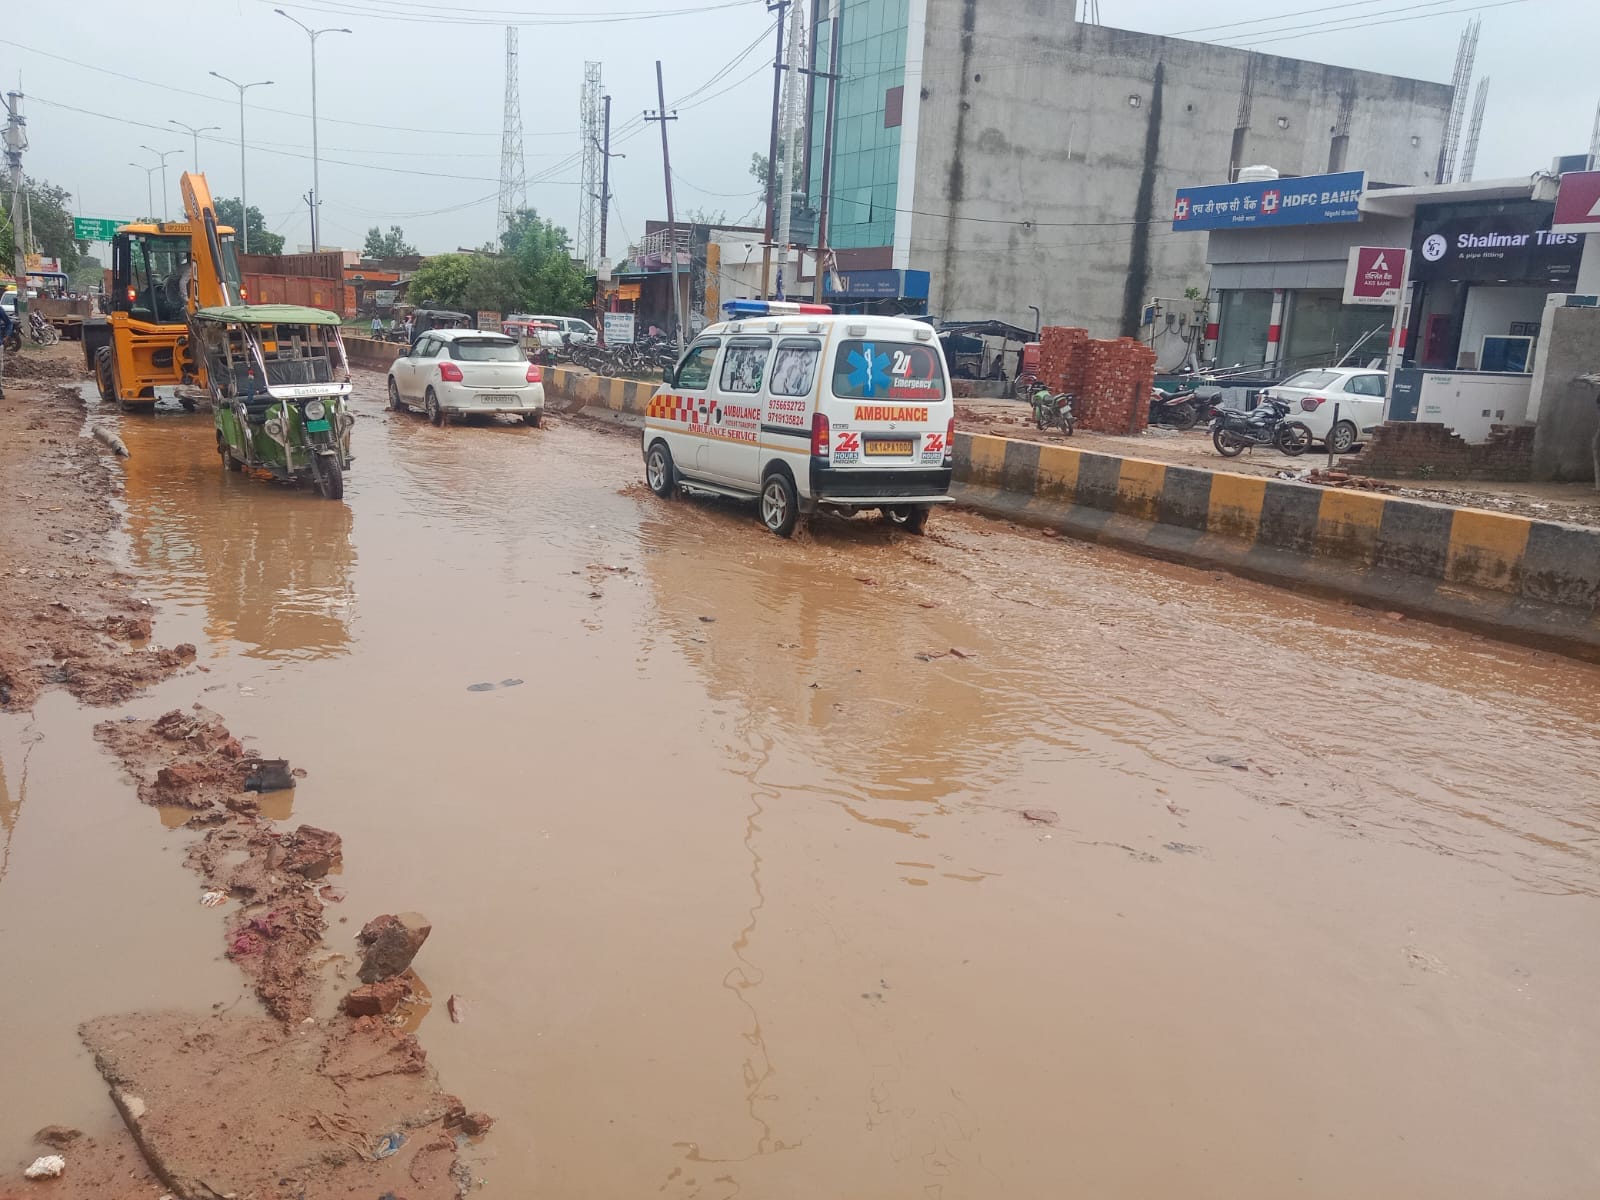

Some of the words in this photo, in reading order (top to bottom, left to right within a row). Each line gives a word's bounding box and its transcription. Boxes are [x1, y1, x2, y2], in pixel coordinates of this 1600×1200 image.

[1282, 193, 1318, 208] HDFC
[1321, 189, 1360, 204] BANK
[1457, 232, 1530, 248] Shalimar
[1535, 230, 1578, 246] Tiles
[893, 378, 932, 389] Emergency
[723, 405, 760, 421] AMBULANCE
[854, 406, 928, 422] AMBULANCE
[688, 423, 726, 437] AMBULANCE
[727, 428, 758, 441] SERVICE
[835, 432, 860, 452] 24
[923, 433, 944, 452] 24
[834, 452, 858, 460] HOURS
